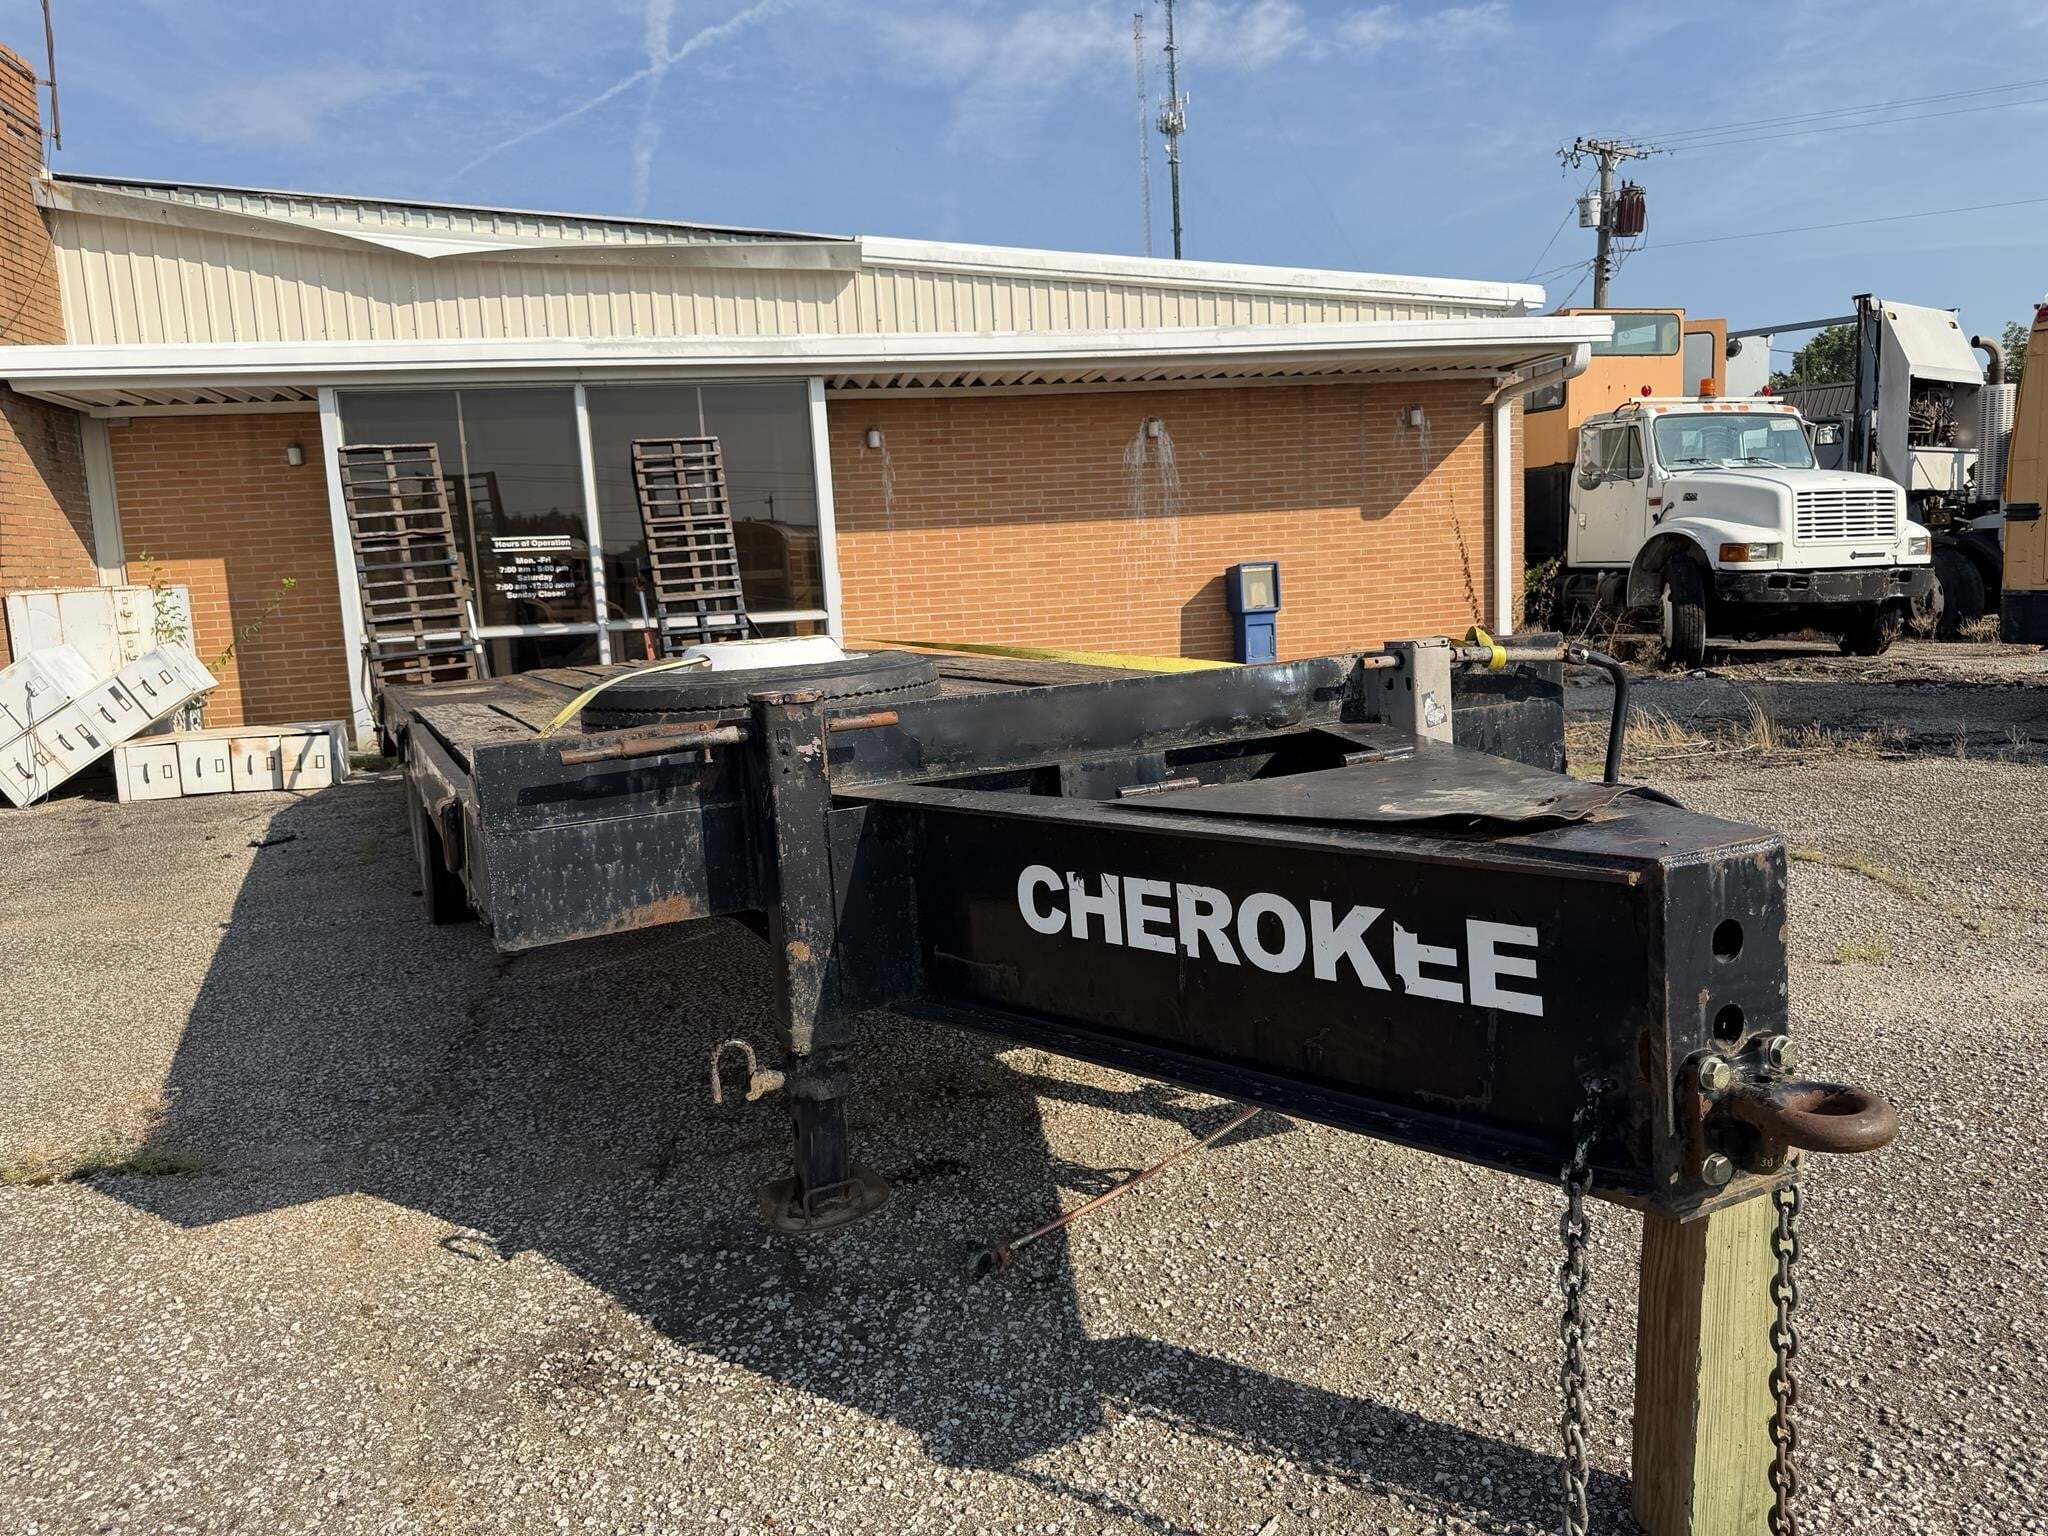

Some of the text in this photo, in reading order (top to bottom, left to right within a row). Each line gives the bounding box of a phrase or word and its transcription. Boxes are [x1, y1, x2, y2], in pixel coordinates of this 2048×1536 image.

[494, 540, 520, 548] Hours
[530, 539, 571, 547] Operation
[555, 565, 569, 573] pm
[517, 574, 553, 582] Saturday
[506, 591, 537, 599] Sunday
[1017, 864, 1544, 1017] CHEROKEE
